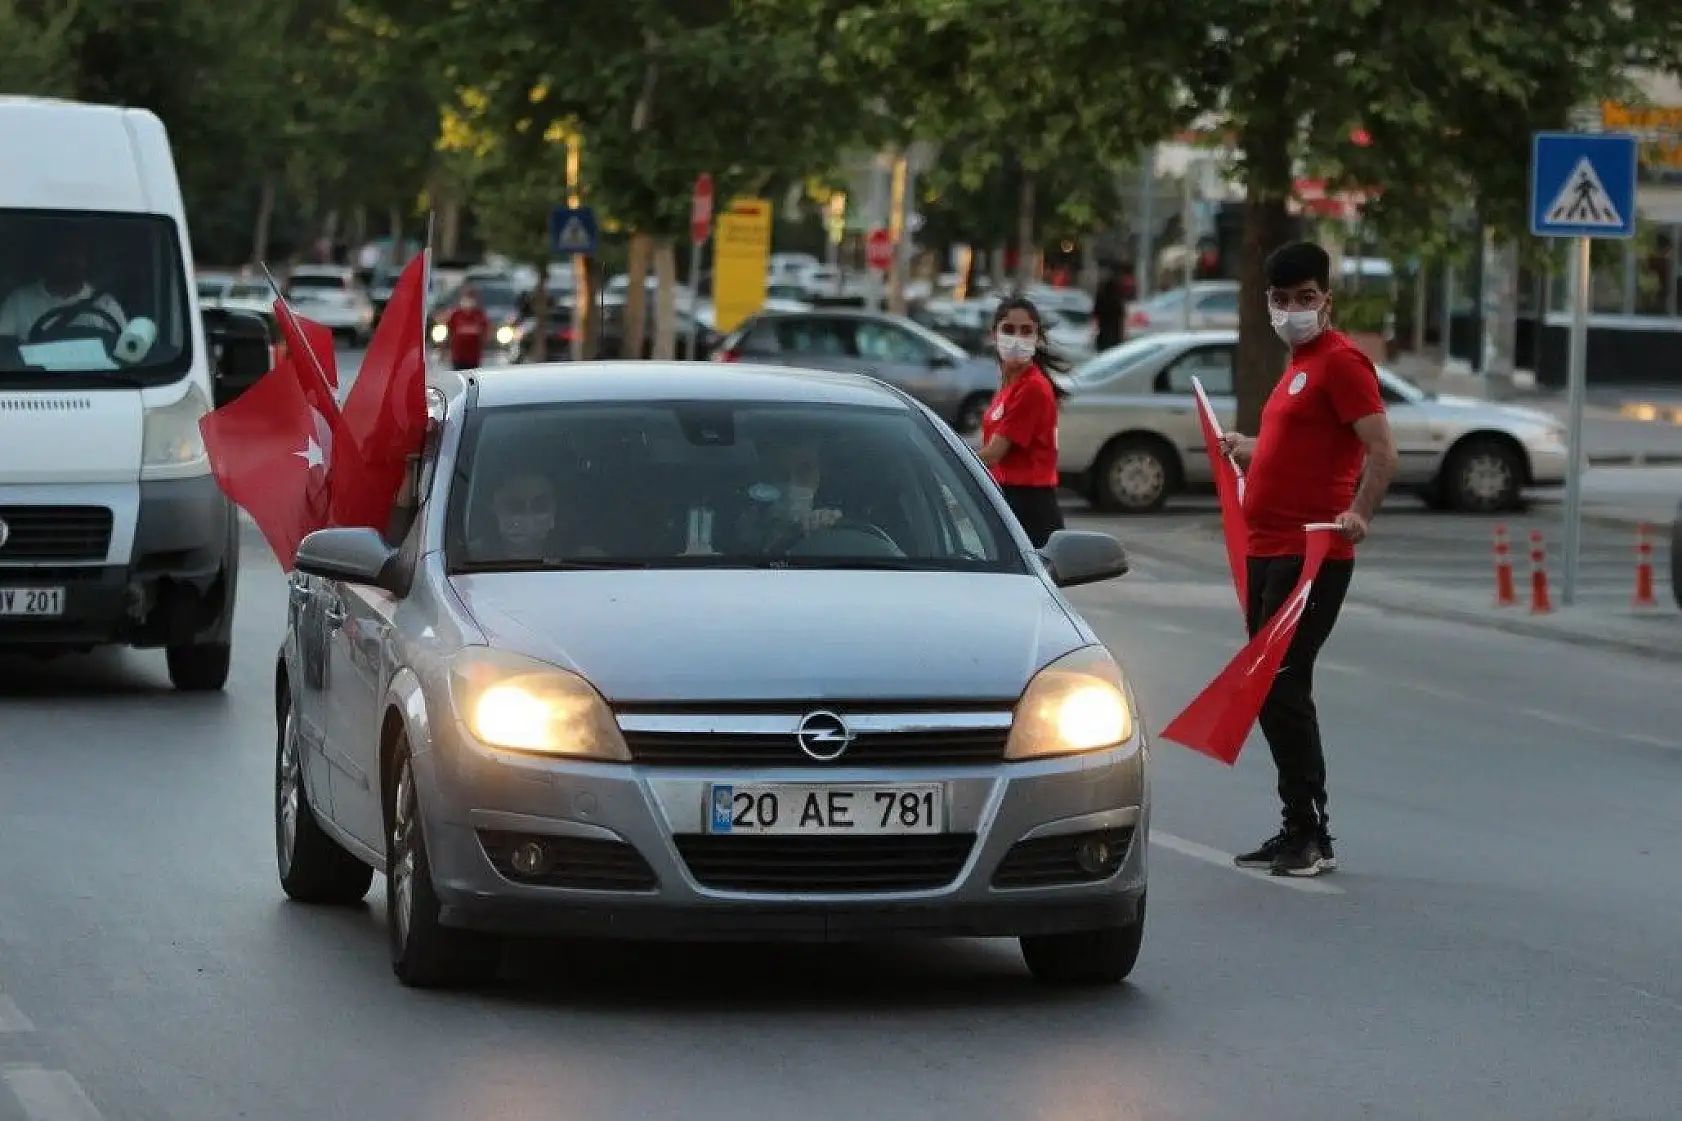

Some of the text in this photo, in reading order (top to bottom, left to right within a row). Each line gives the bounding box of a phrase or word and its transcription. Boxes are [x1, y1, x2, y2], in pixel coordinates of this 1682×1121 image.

[25, 591, 58, 613] 201
[732, 792, 933, 827] 20 AE 781
